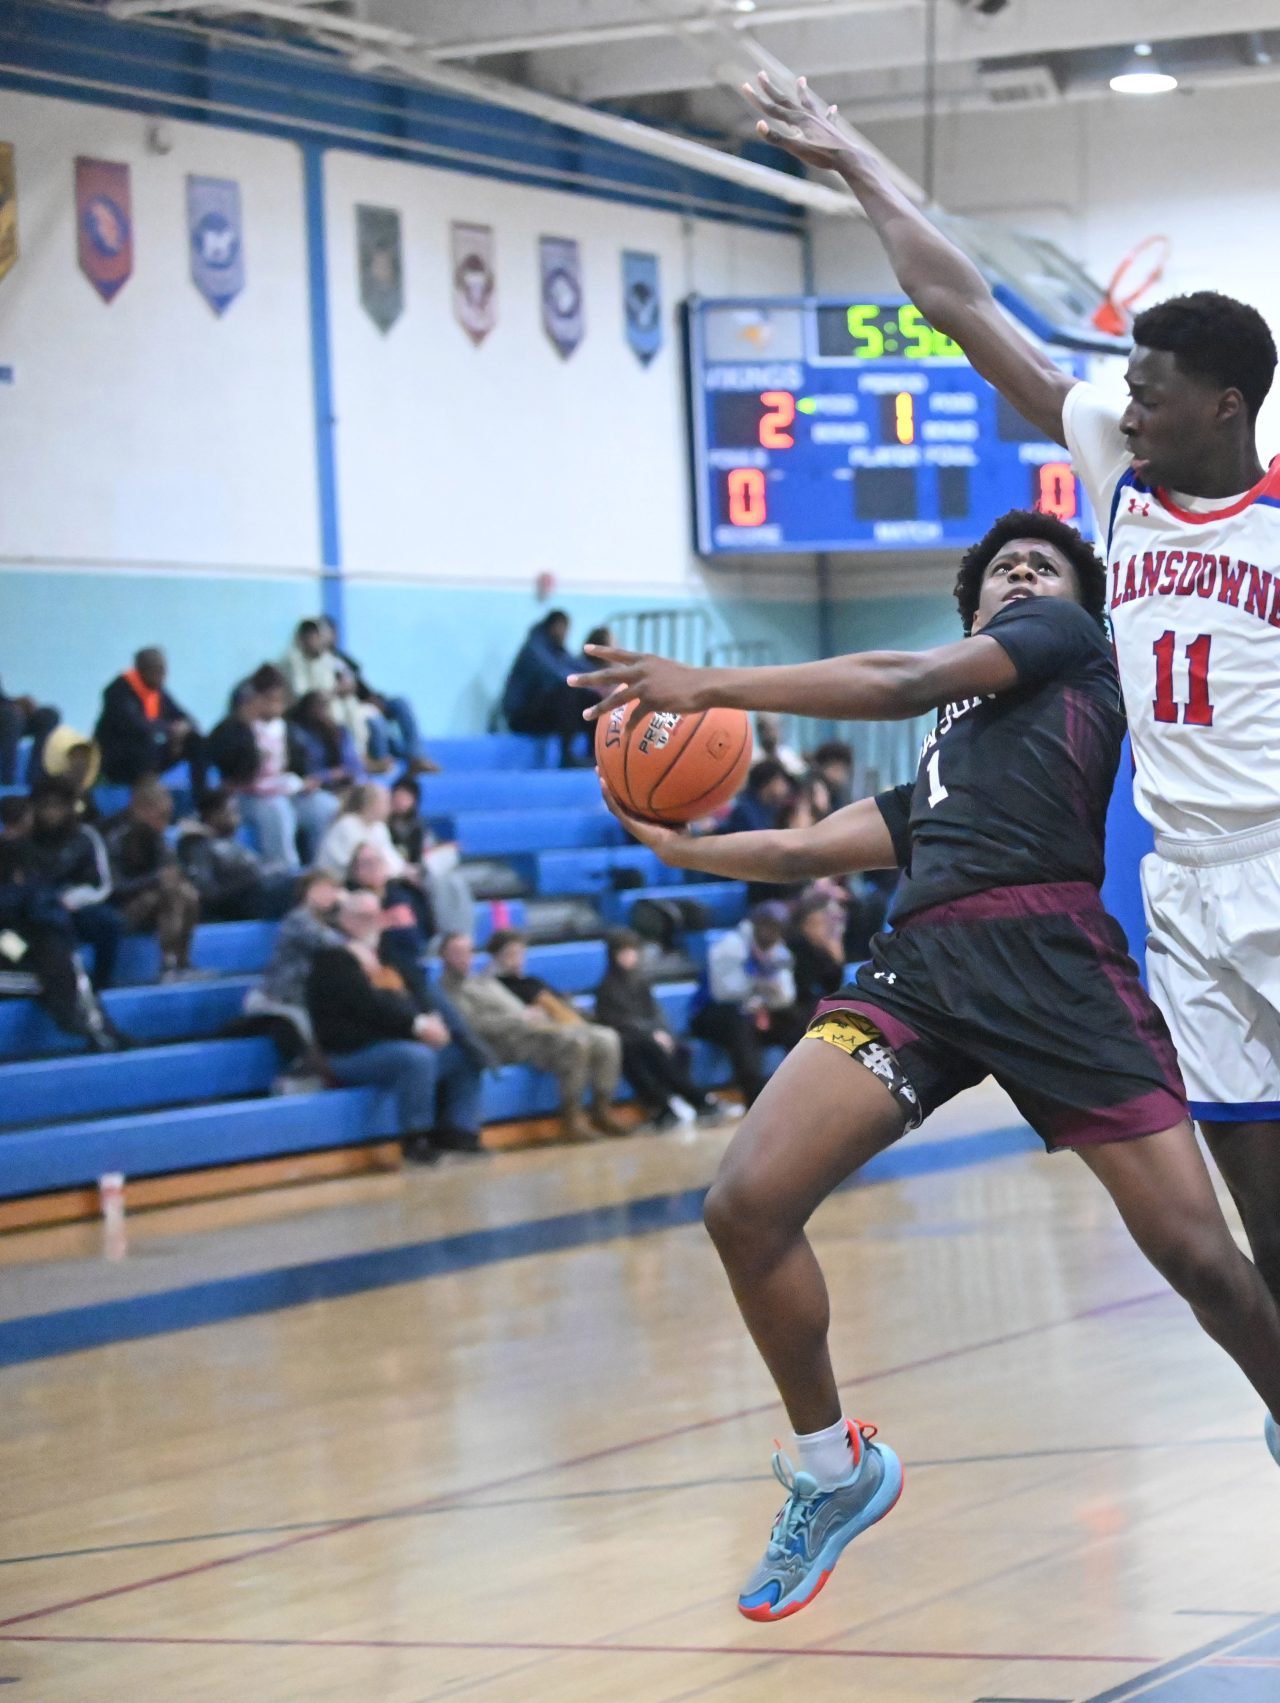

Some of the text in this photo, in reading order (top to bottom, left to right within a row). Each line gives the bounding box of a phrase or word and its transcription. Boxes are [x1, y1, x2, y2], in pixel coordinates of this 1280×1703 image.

[759, 391, 795, 449] 2
[896, 392, 914, 444] 1
[728, 468, 766, 526] 0
[1040, 463, 1076, 520] 0
[1153, 630, 1214, 727] 11
[927, 749, 949, 809] 1
